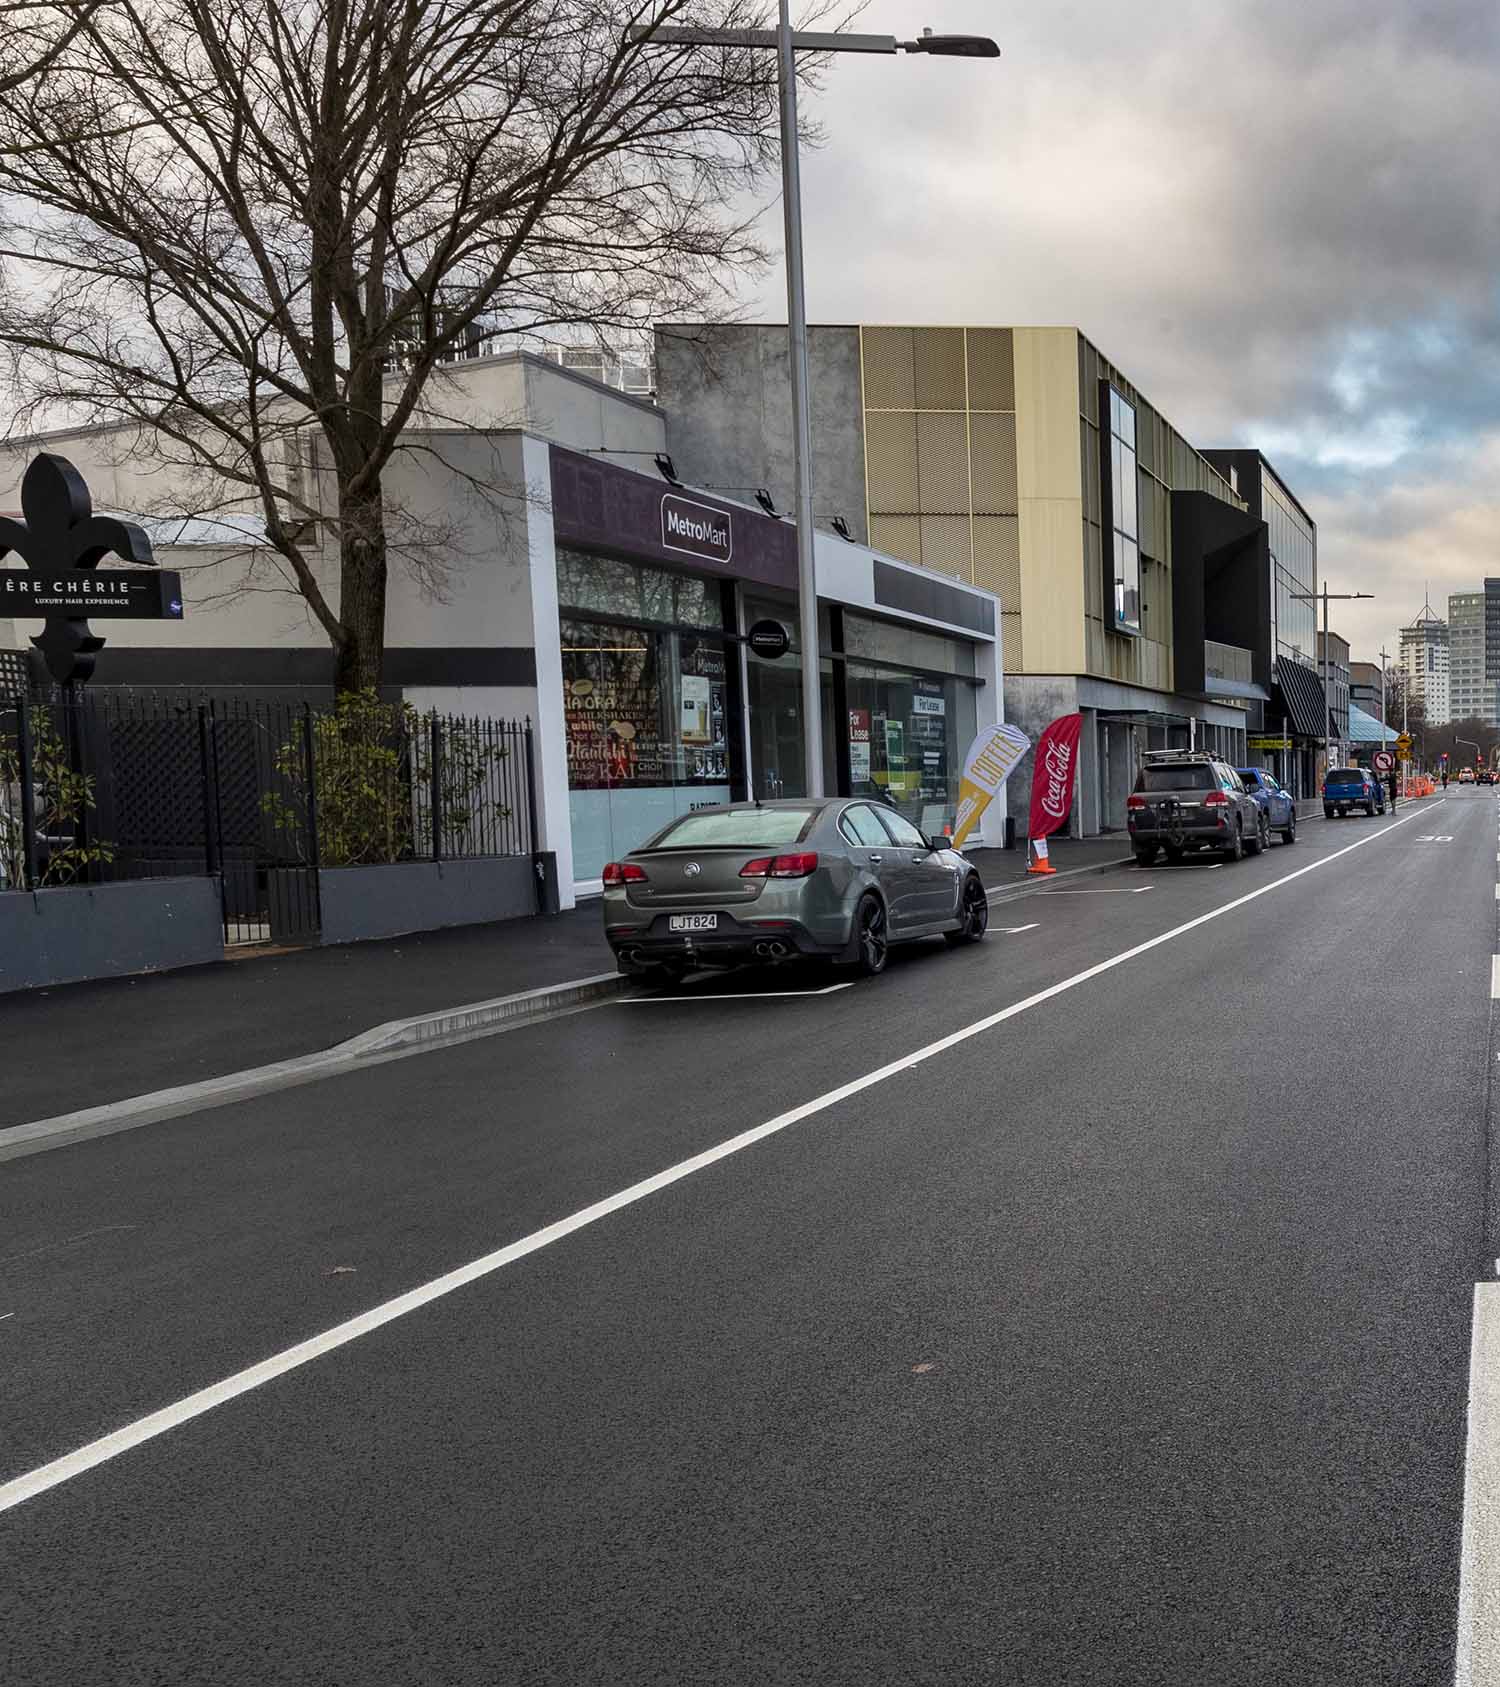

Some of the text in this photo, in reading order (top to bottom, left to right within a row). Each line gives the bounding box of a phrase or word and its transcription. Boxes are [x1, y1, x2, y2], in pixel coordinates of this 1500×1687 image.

[667, 510, 728, 548] MetroMart
[35, 597, 64, 606] LUXURY
[85, 598, 129, 606] EXPERIENCE
[849, 711, 860, 726] For
[849, 726, 869, 741] Lease
[971, 732, 1024, 786] COFFEE
[671, 915, 716, 930] LJT824
